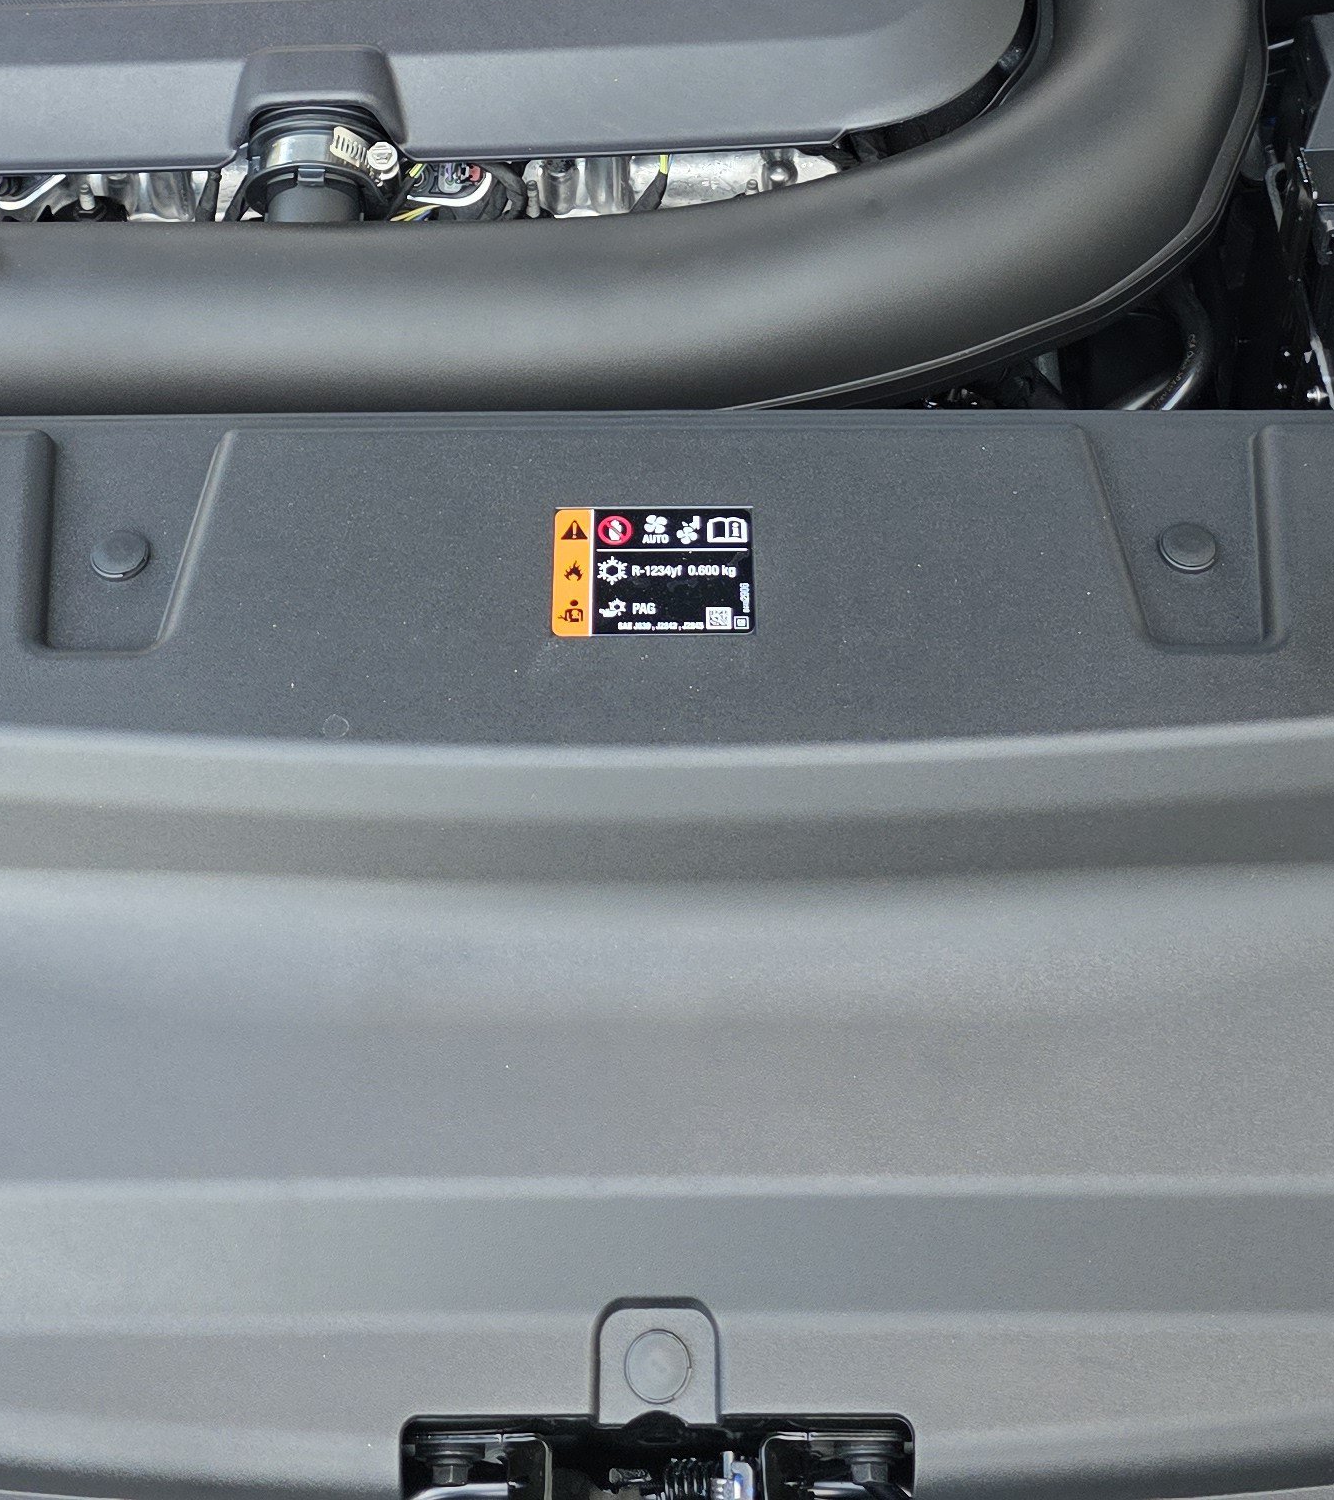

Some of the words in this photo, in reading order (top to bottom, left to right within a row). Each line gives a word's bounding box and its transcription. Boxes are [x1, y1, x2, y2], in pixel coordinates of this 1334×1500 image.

[641, 534, 669, 545] AUTO
[631, 565, 683, 579] R-1234yf
[687, 565, 720, 577] 0.600
[721, 565, 737, 578] kg
[631, 602, 657, 615] PAG
